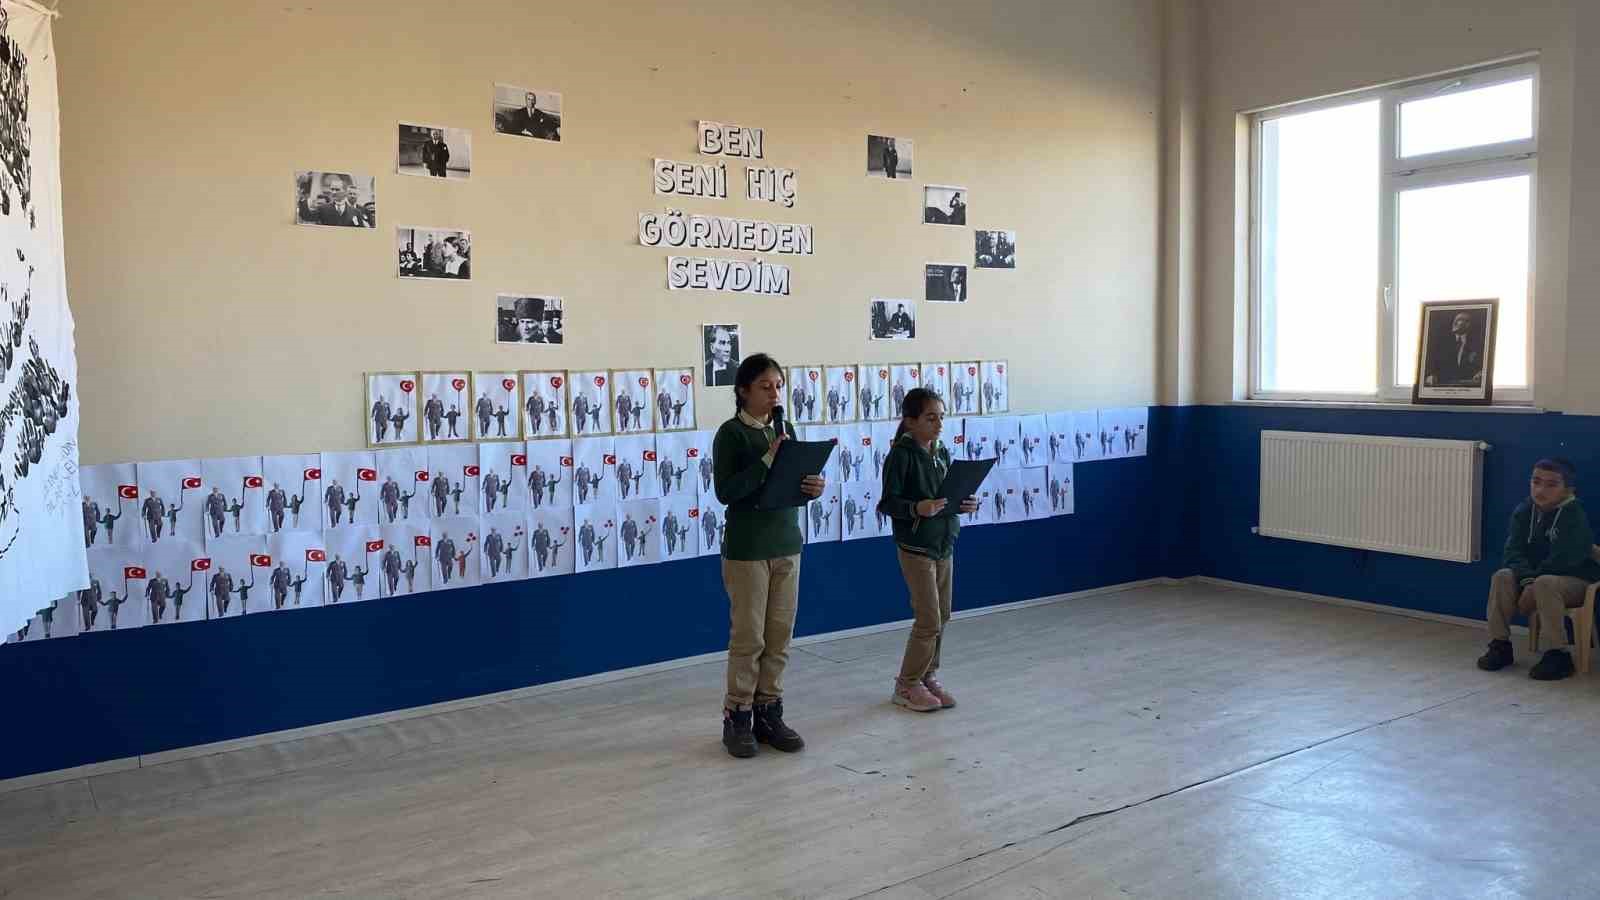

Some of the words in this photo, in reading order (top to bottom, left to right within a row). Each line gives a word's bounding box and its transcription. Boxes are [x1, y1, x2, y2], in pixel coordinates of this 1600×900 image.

[700, 123, 763, 159] BEN
[655, 160, 727, 198] SENİ
[639, 209, 814, 254] GÖRMEDEN
[670, 256, 790, 295] SEVDİM
